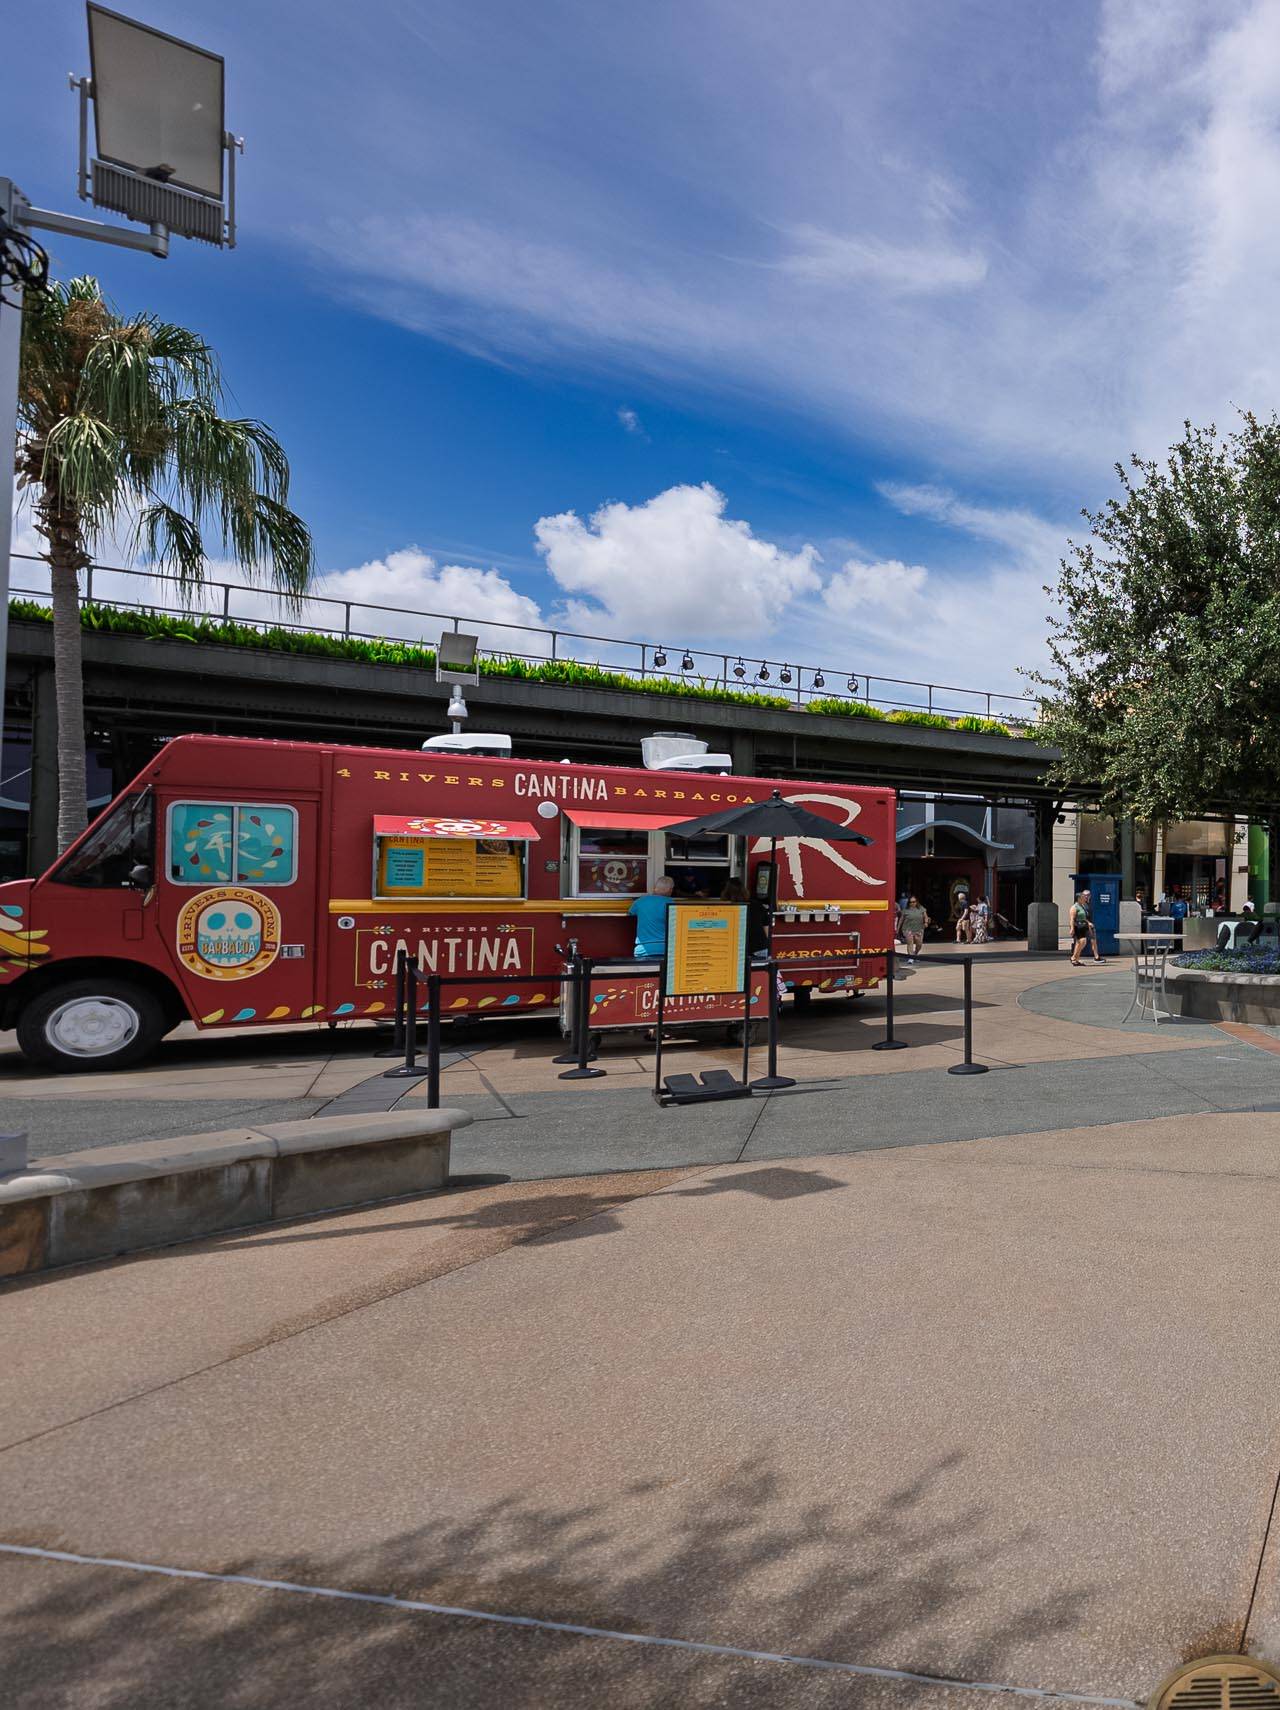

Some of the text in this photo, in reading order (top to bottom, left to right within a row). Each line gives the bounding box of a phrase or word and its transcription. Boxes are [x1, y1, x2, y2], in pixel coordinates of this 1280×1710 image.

[336, 768, 755, 804] 4 RIVERS CANTINA BARBACOA
[234, 890, 275, 938] CANTINA
[369, 937, 522, 976] CANTINA
